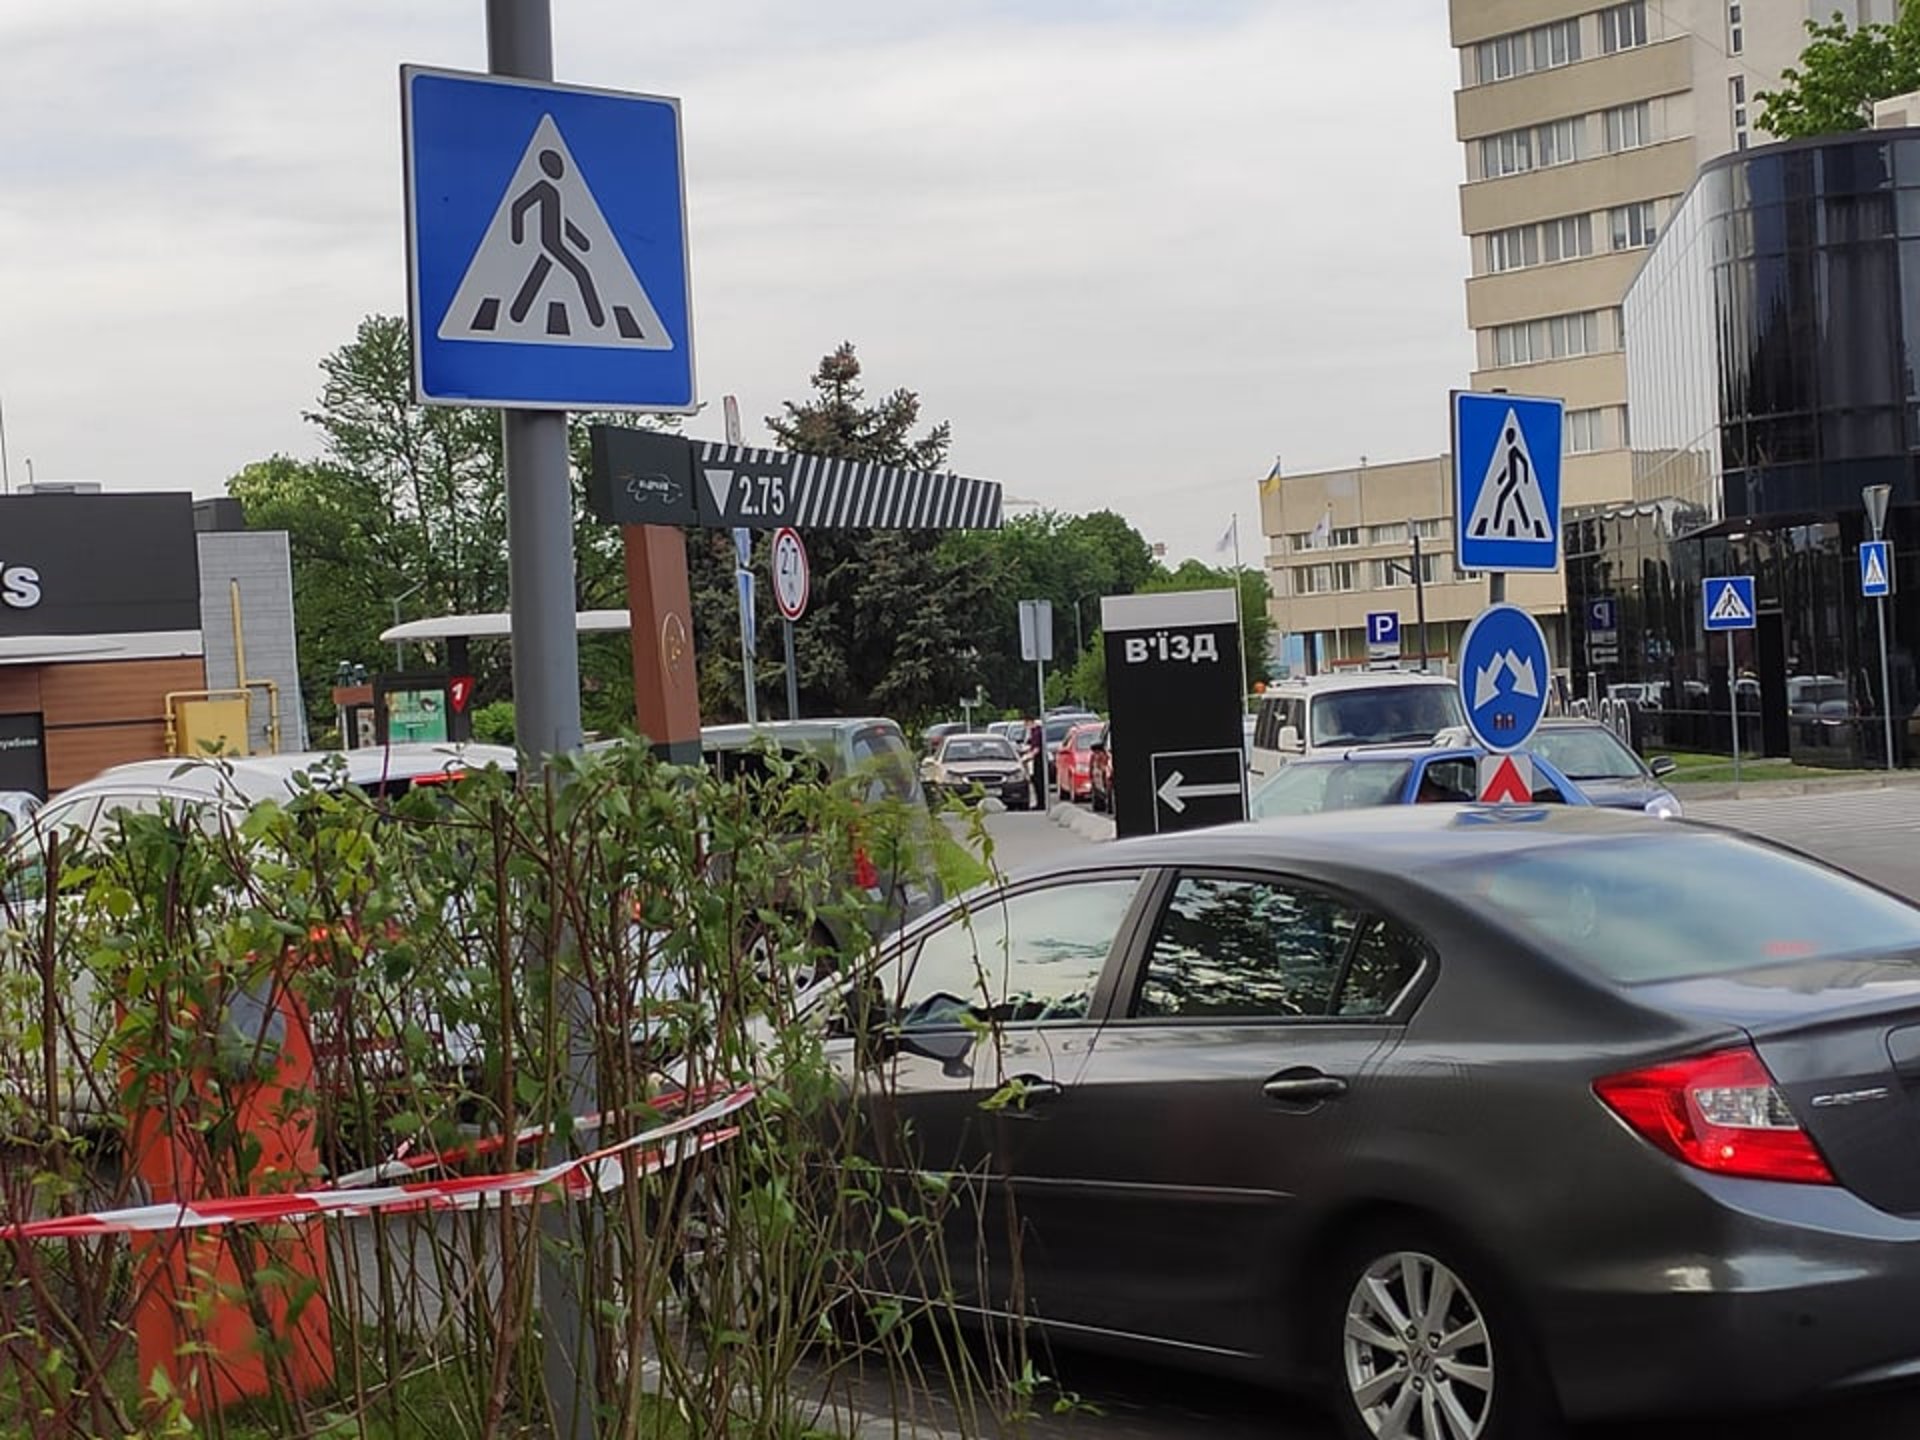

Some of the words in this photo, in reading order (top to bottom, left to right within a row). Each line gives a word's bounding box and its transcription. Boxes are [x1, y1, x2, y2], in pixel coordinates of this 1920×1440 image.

[739, 475, 785, 515] 2.75
[1375, 615, 1393, 641] P
[1124, 630, 1219, 664] В'ЇЗД
[451, 682, 464, 701] 1
